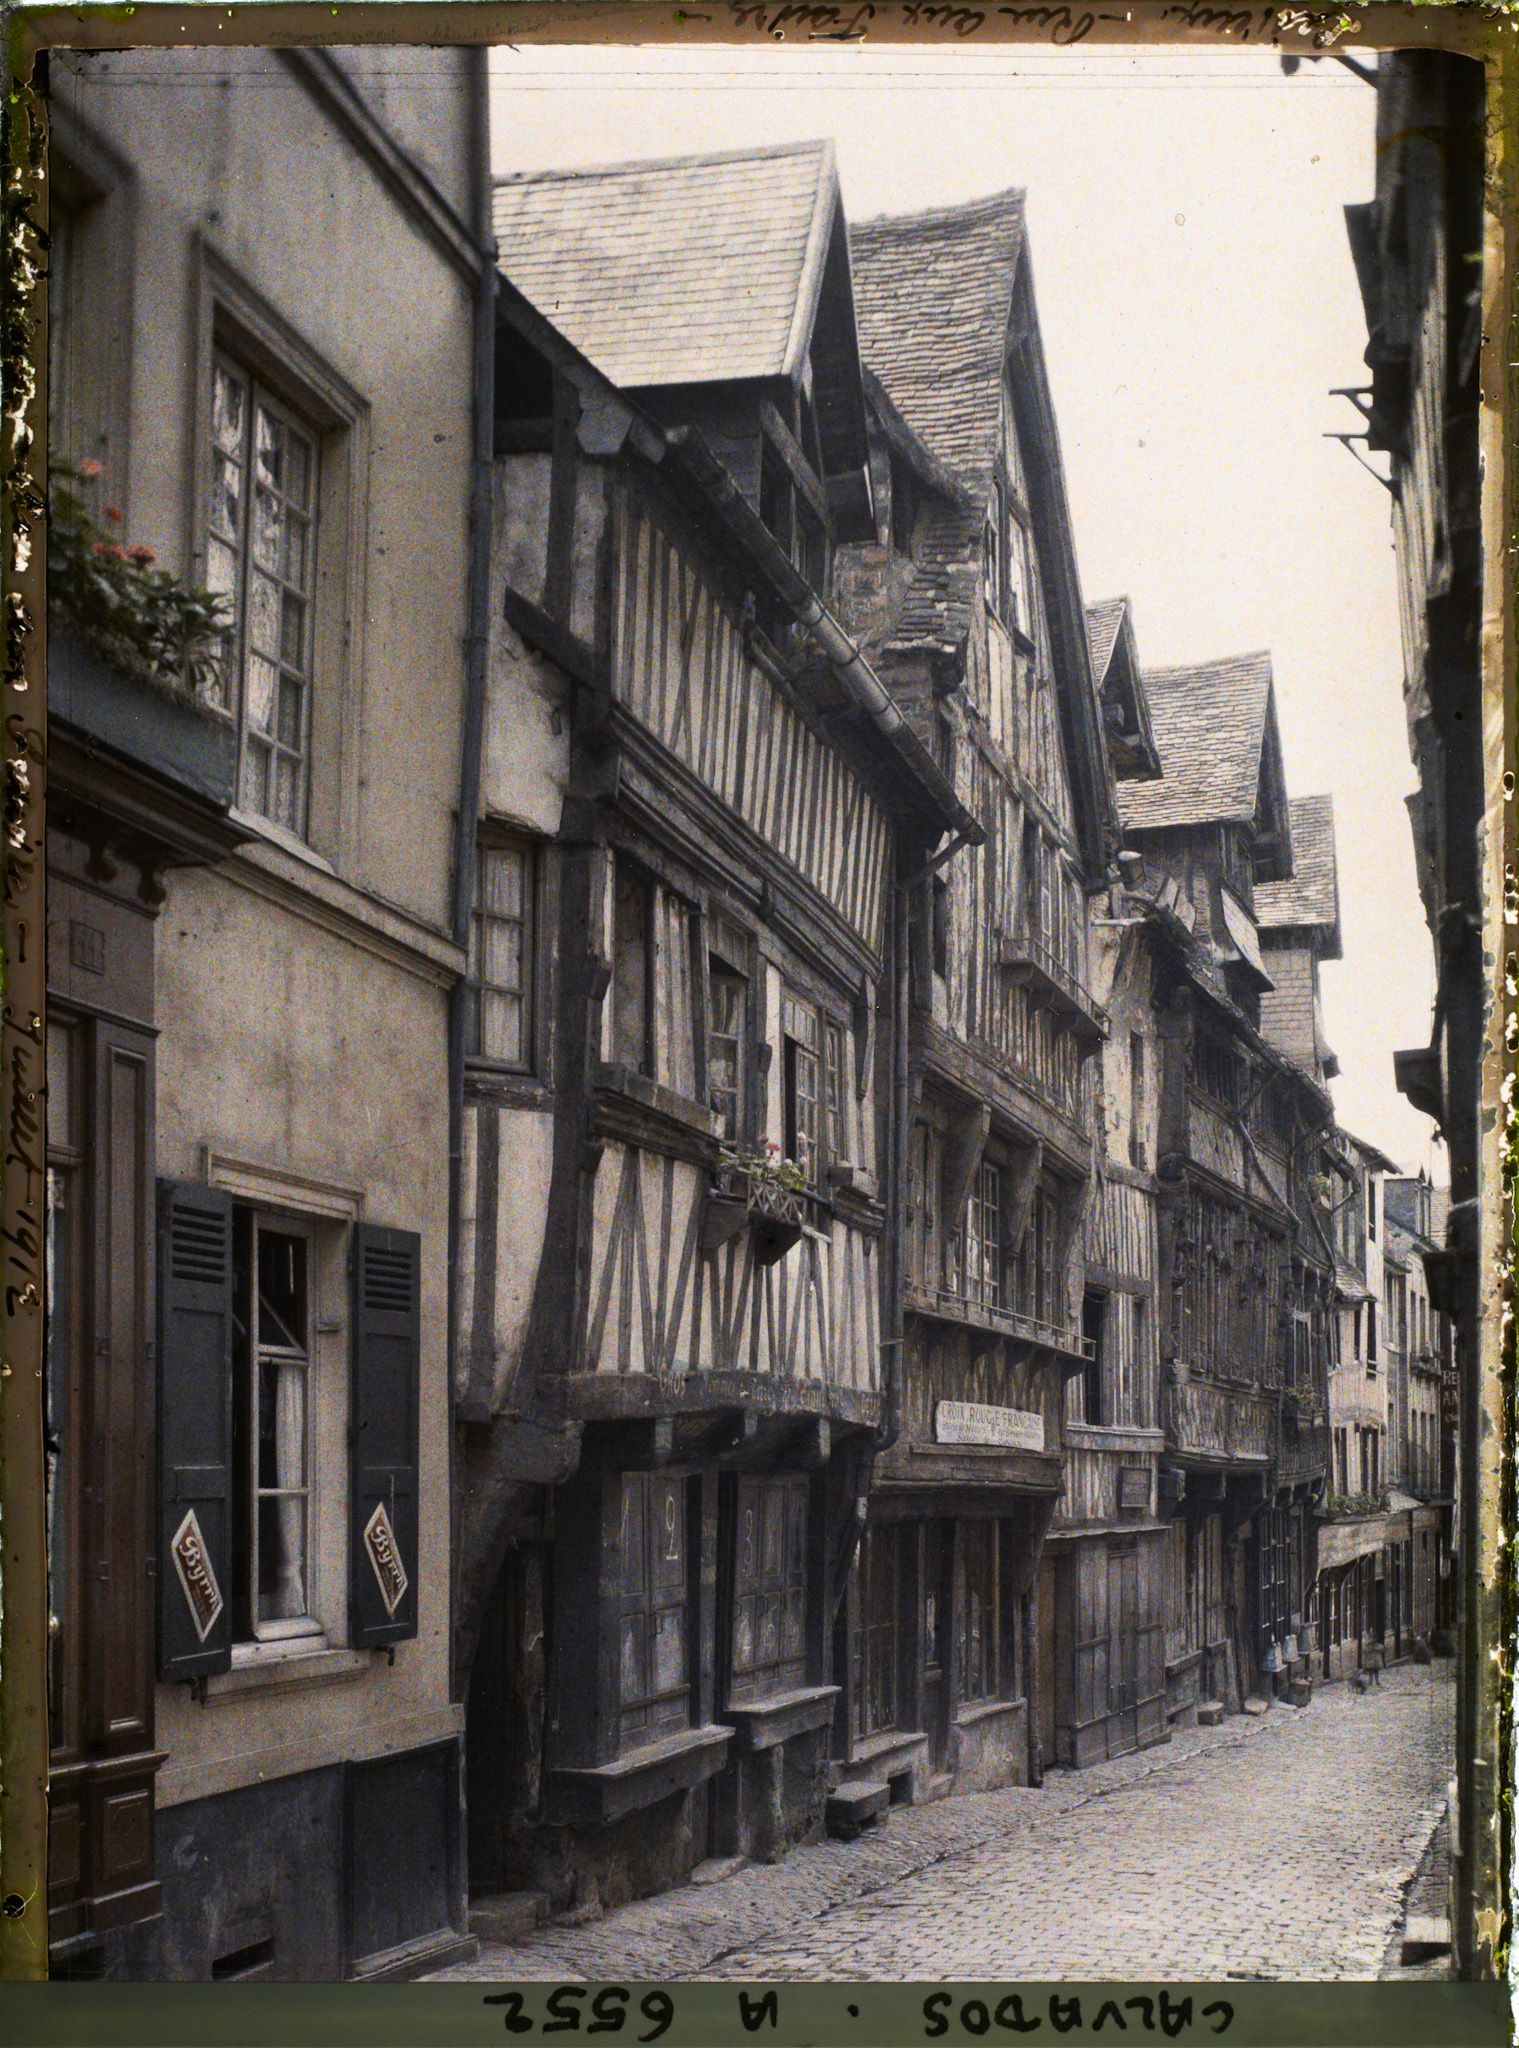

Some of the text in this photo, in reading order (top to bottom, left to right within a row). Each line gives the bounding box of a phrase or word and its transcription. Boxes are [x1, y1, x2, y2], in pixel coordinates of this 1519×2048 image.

[902, 3, 985, 37] aux
[998, 8, 1094, 46] Rue
[2, 1006, 44, 1176] Juillet
[941, 1402, 965, 1421] CROIX
[969, 1406, 1000, 1427] ROUGE
[180, 1536, 222, 1611] Byrrh
[371, 1525, 404, 1589] Byrrh
[483, 1987, 677, 2043] 6552
[923, 1991, 1235, 2036] CALVADOS
